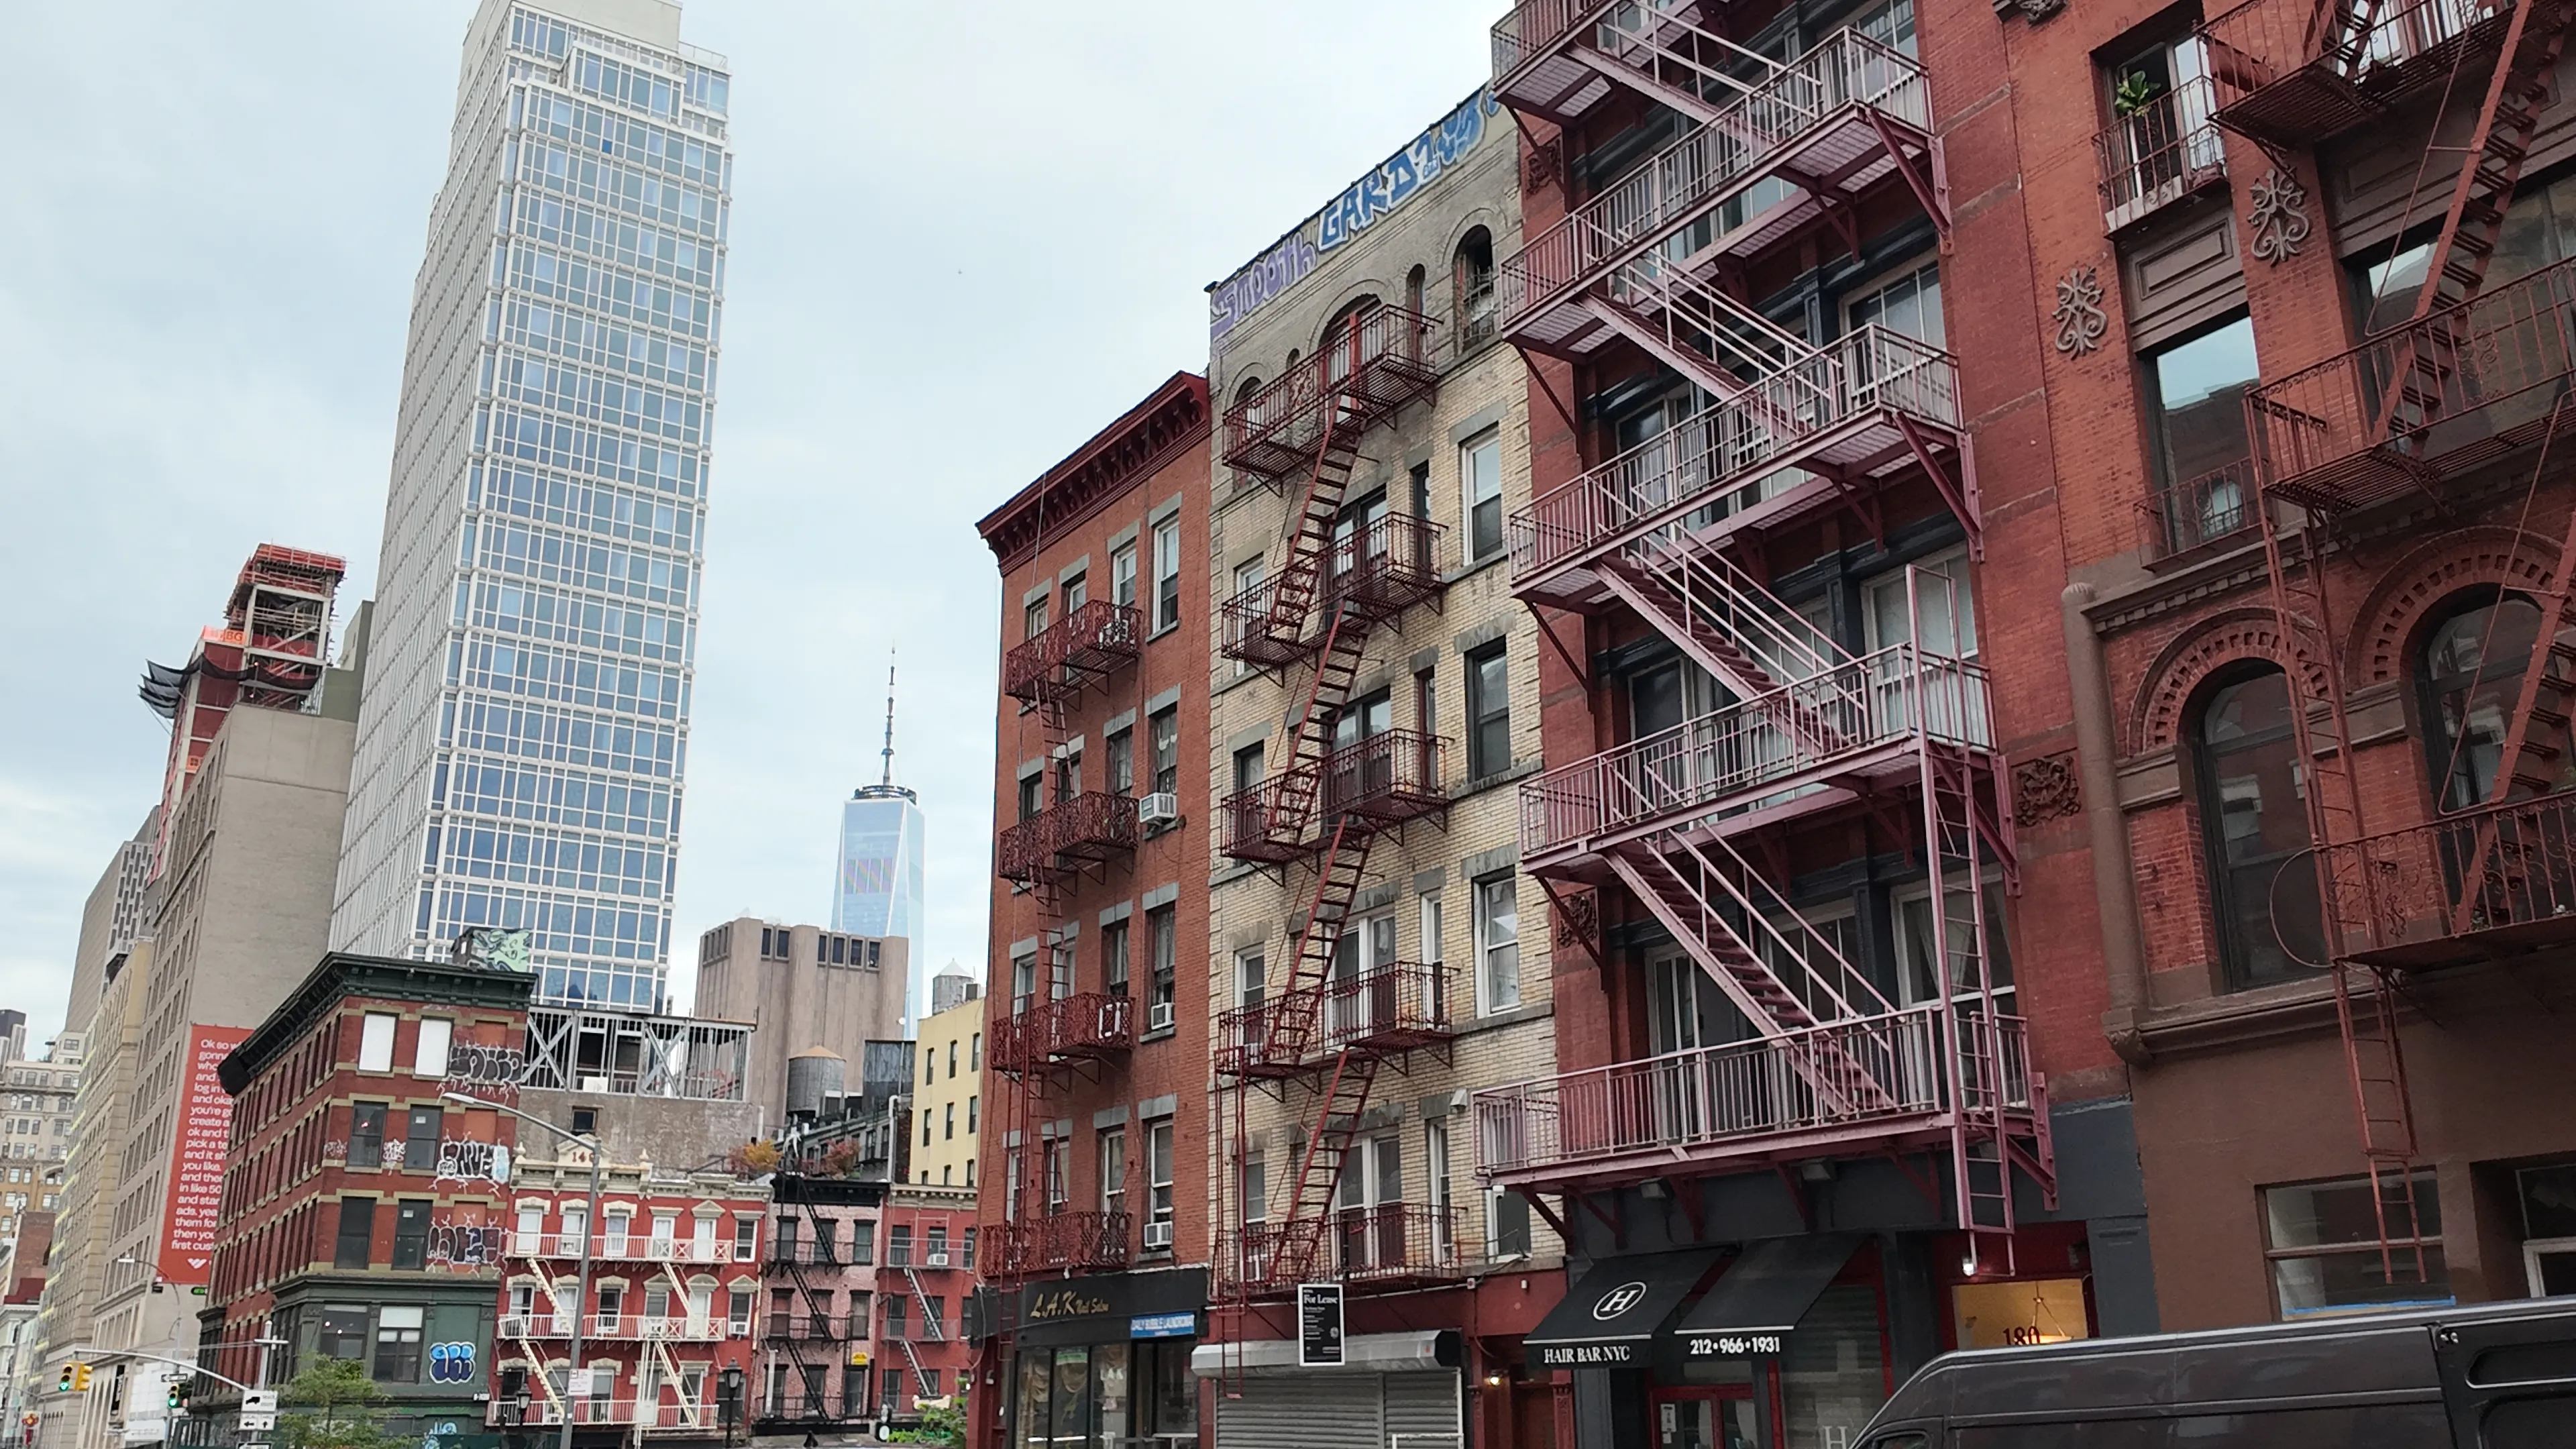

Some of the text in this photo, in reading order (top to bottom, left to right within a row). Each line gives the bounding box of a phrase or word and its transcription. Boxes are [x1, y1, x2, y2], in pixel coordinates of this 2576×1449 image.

[201, 1039, 215, 1049] Ok
[196, 1073, 216, 1081] and
[193, 1095, 213, 1104] and
[187, 1127, 200, 1136] ok
[201, 1128, 222, 1138] and
[185, 1138, 207, 1149] pick
[184, 1150, 205, 1159] and
[182, 1163, 201, 1171] you
[180, 1172, 201, 1181] and
[178, 1195, 199, 1204] and
[174, 1229, 197, 1238] then
[1303, 1293, 1338, 1303] For Lease
[1600, 1289, 1640, 1311] H
[1544, 1346, 1630, 1364] HAIR BAR NYC
